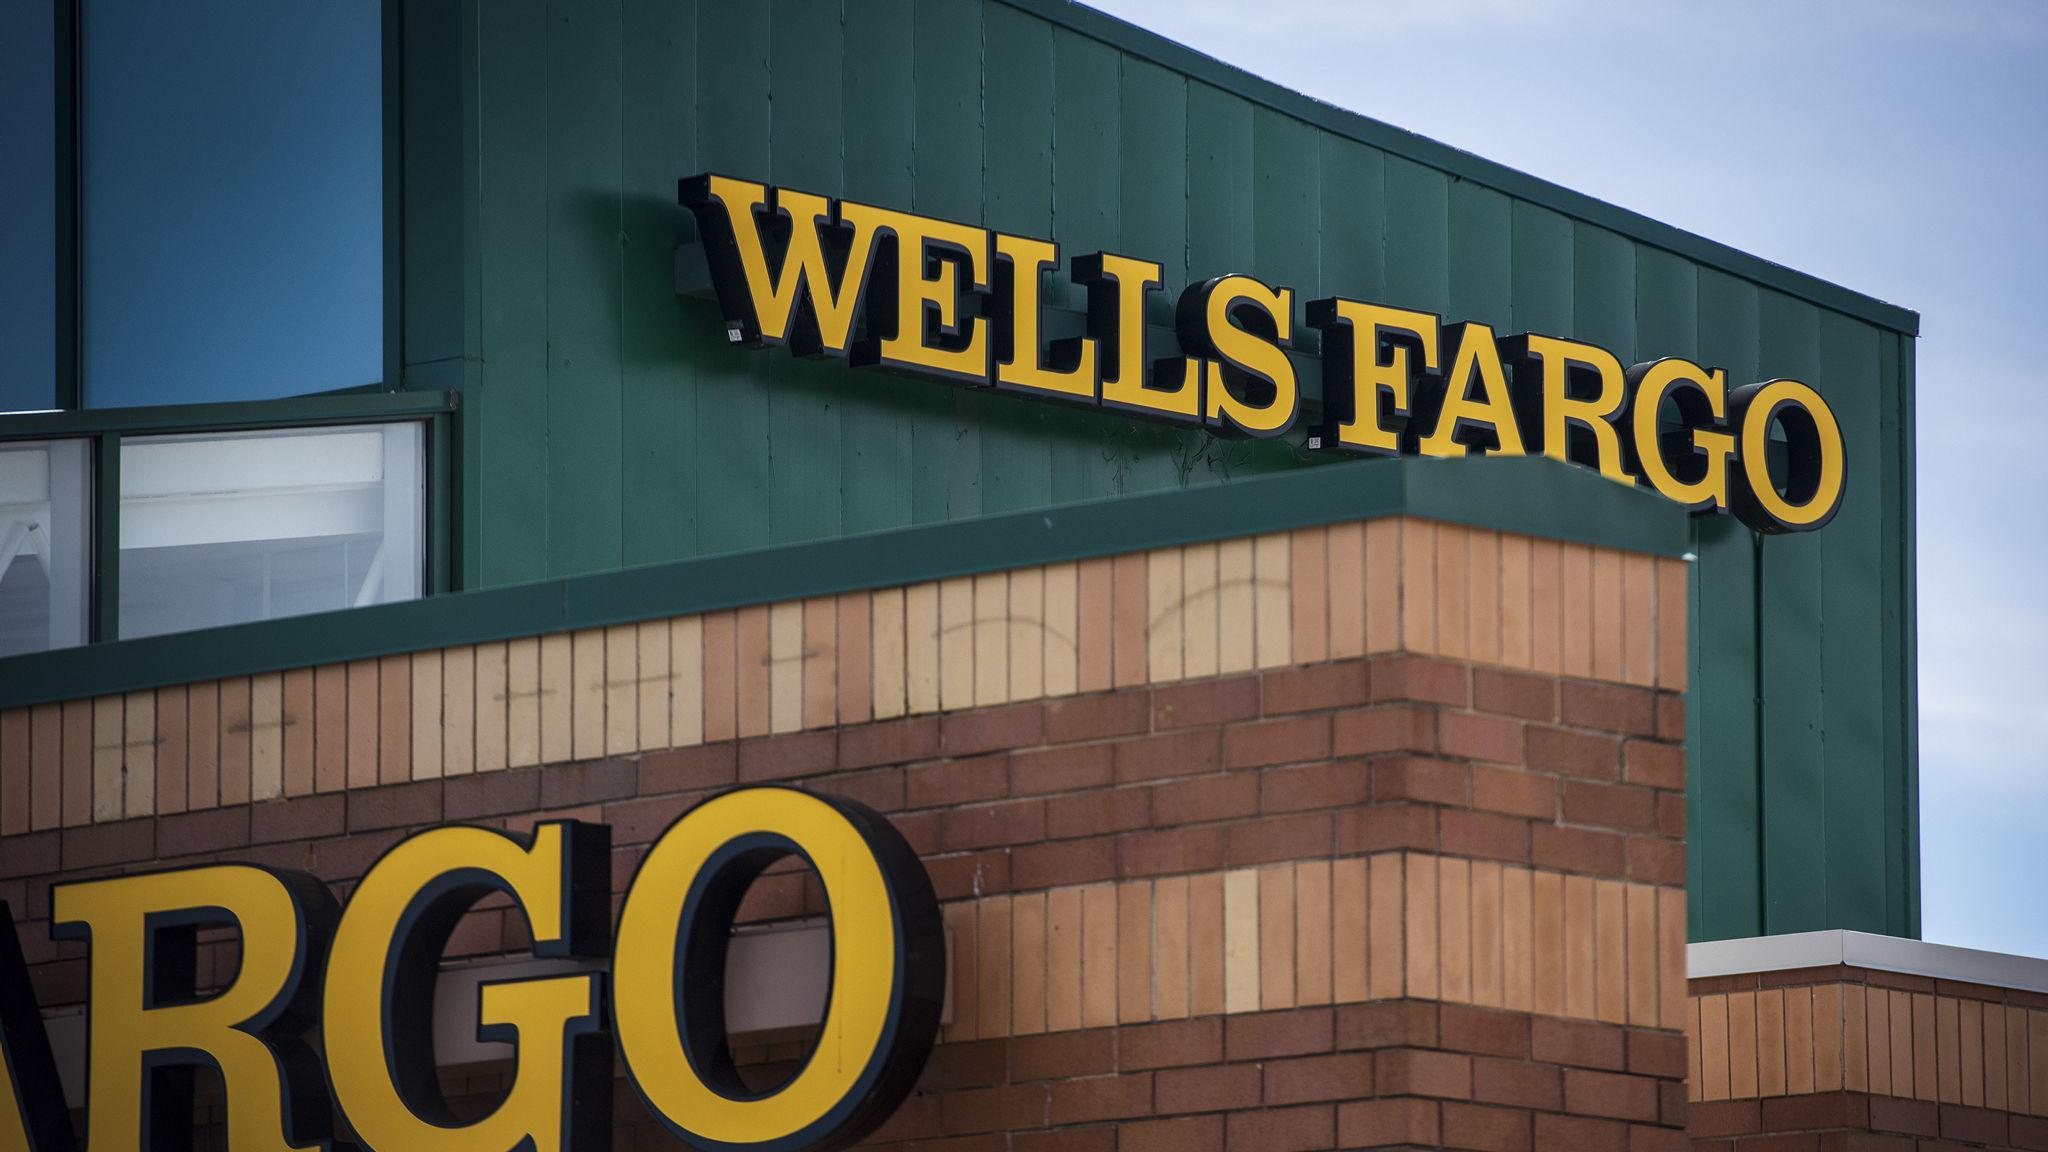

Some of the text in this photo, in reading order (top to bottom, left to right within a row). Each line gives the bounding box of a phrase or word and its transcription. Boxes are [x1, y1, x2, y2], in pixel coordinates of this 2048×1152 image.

[707, 175, 1847, 529] WELLS FARGO
[0, 786, 907, 1152] RGO
